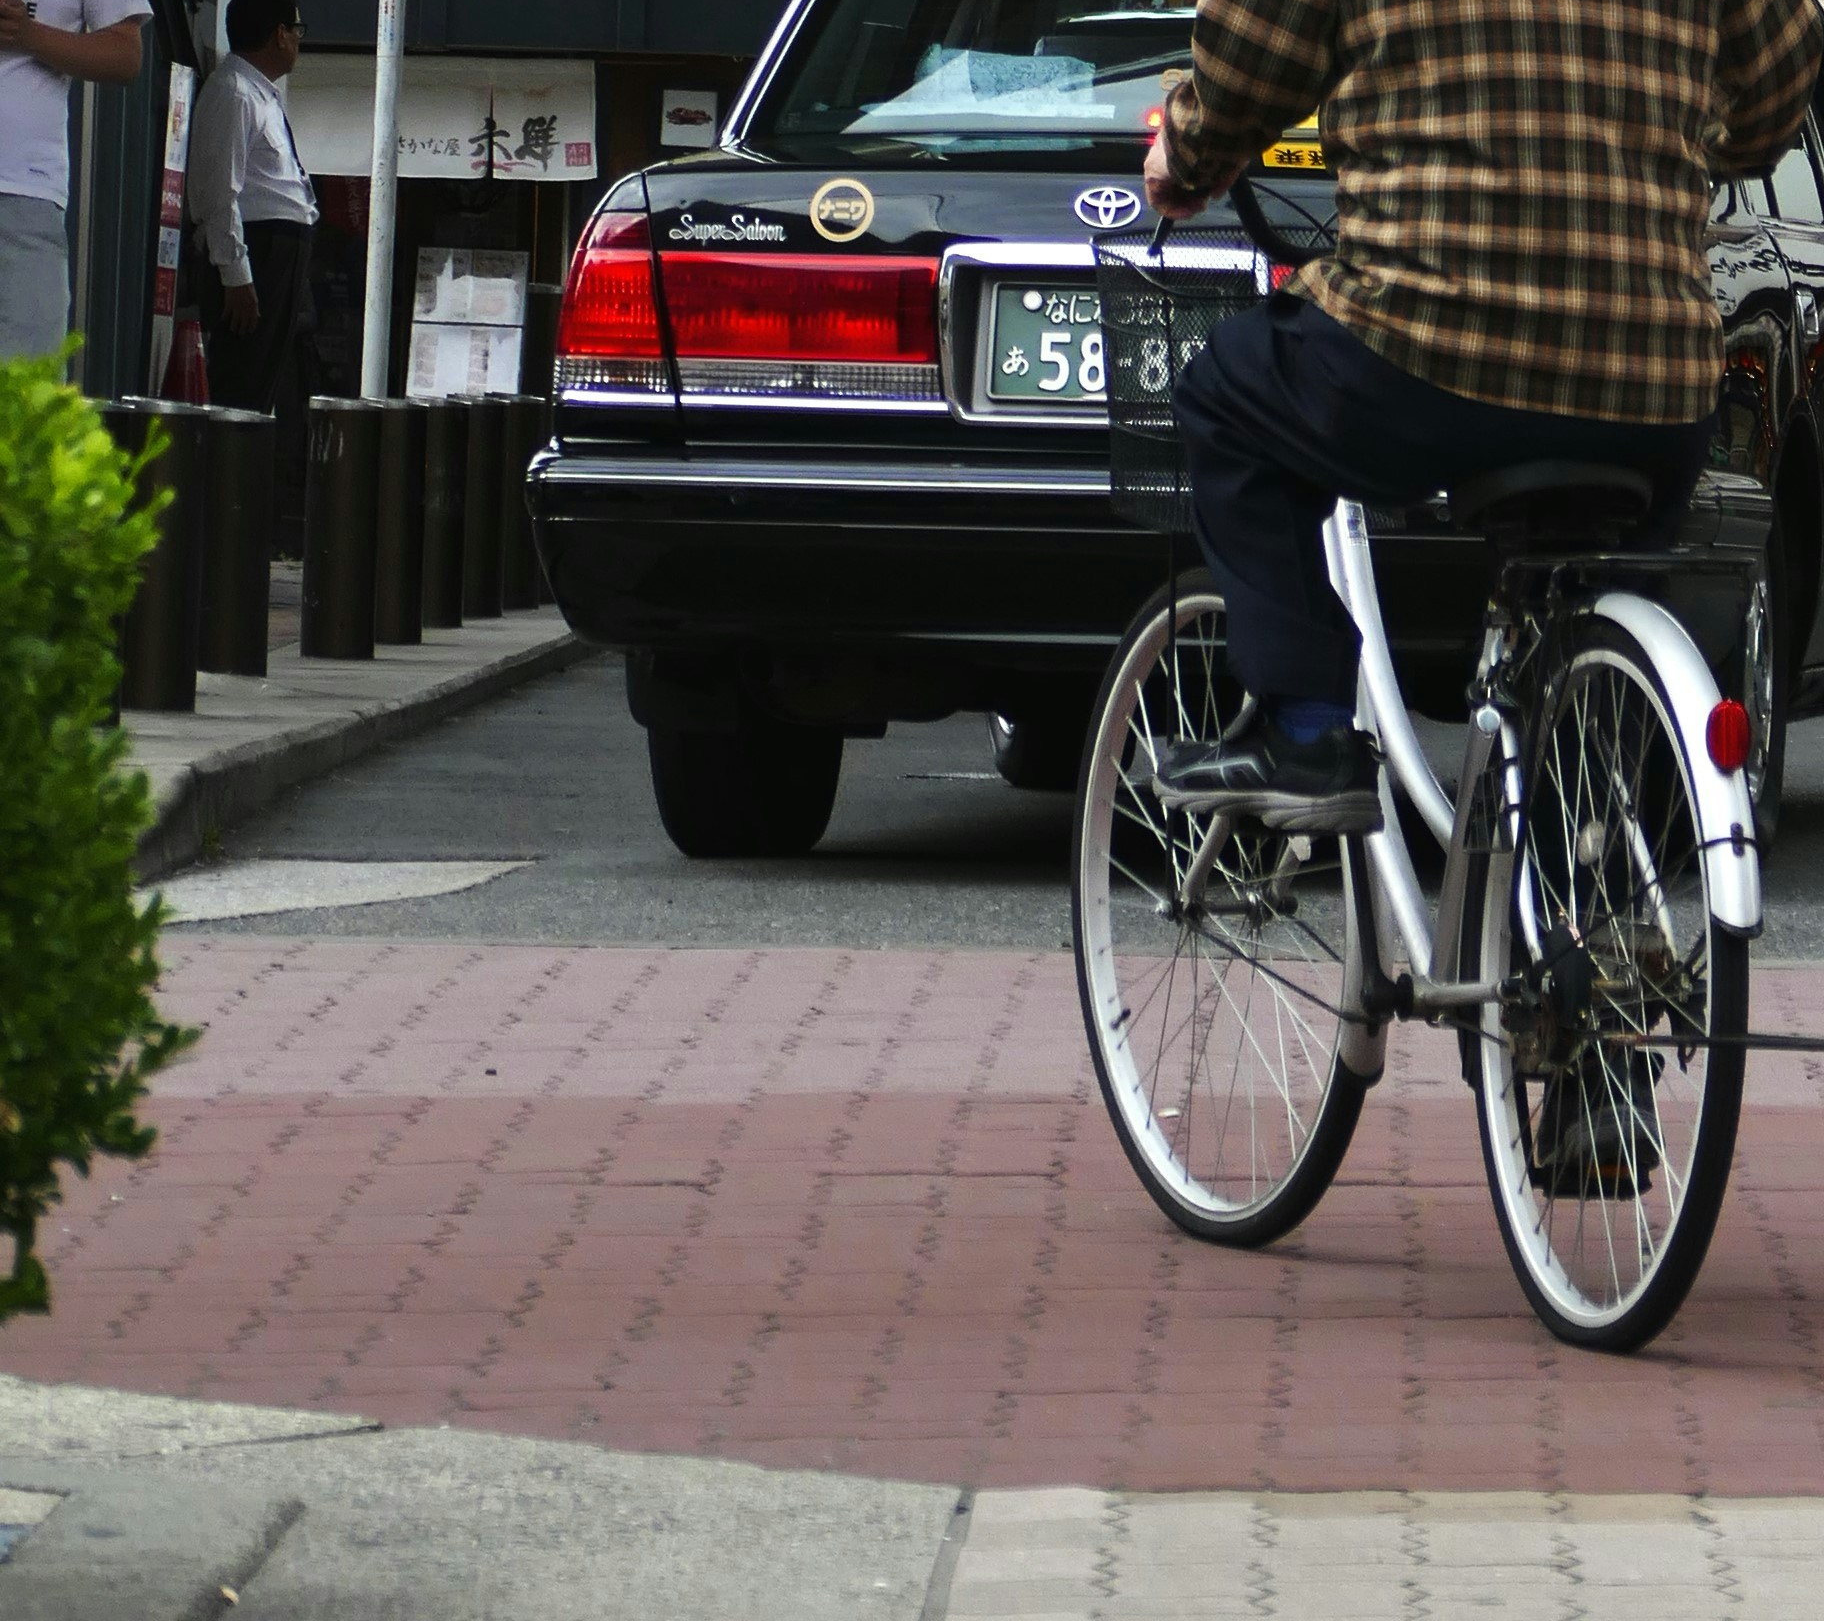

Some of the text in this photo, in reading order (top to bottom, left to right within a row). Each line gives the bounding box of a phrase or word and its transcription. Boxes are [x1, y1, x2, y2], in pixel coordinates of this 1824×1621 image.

[818, 199, 866, 221] ナニワ
[669, 214, 787, 246] Super Saloon
[1001, 346, 1031, 378] あ
